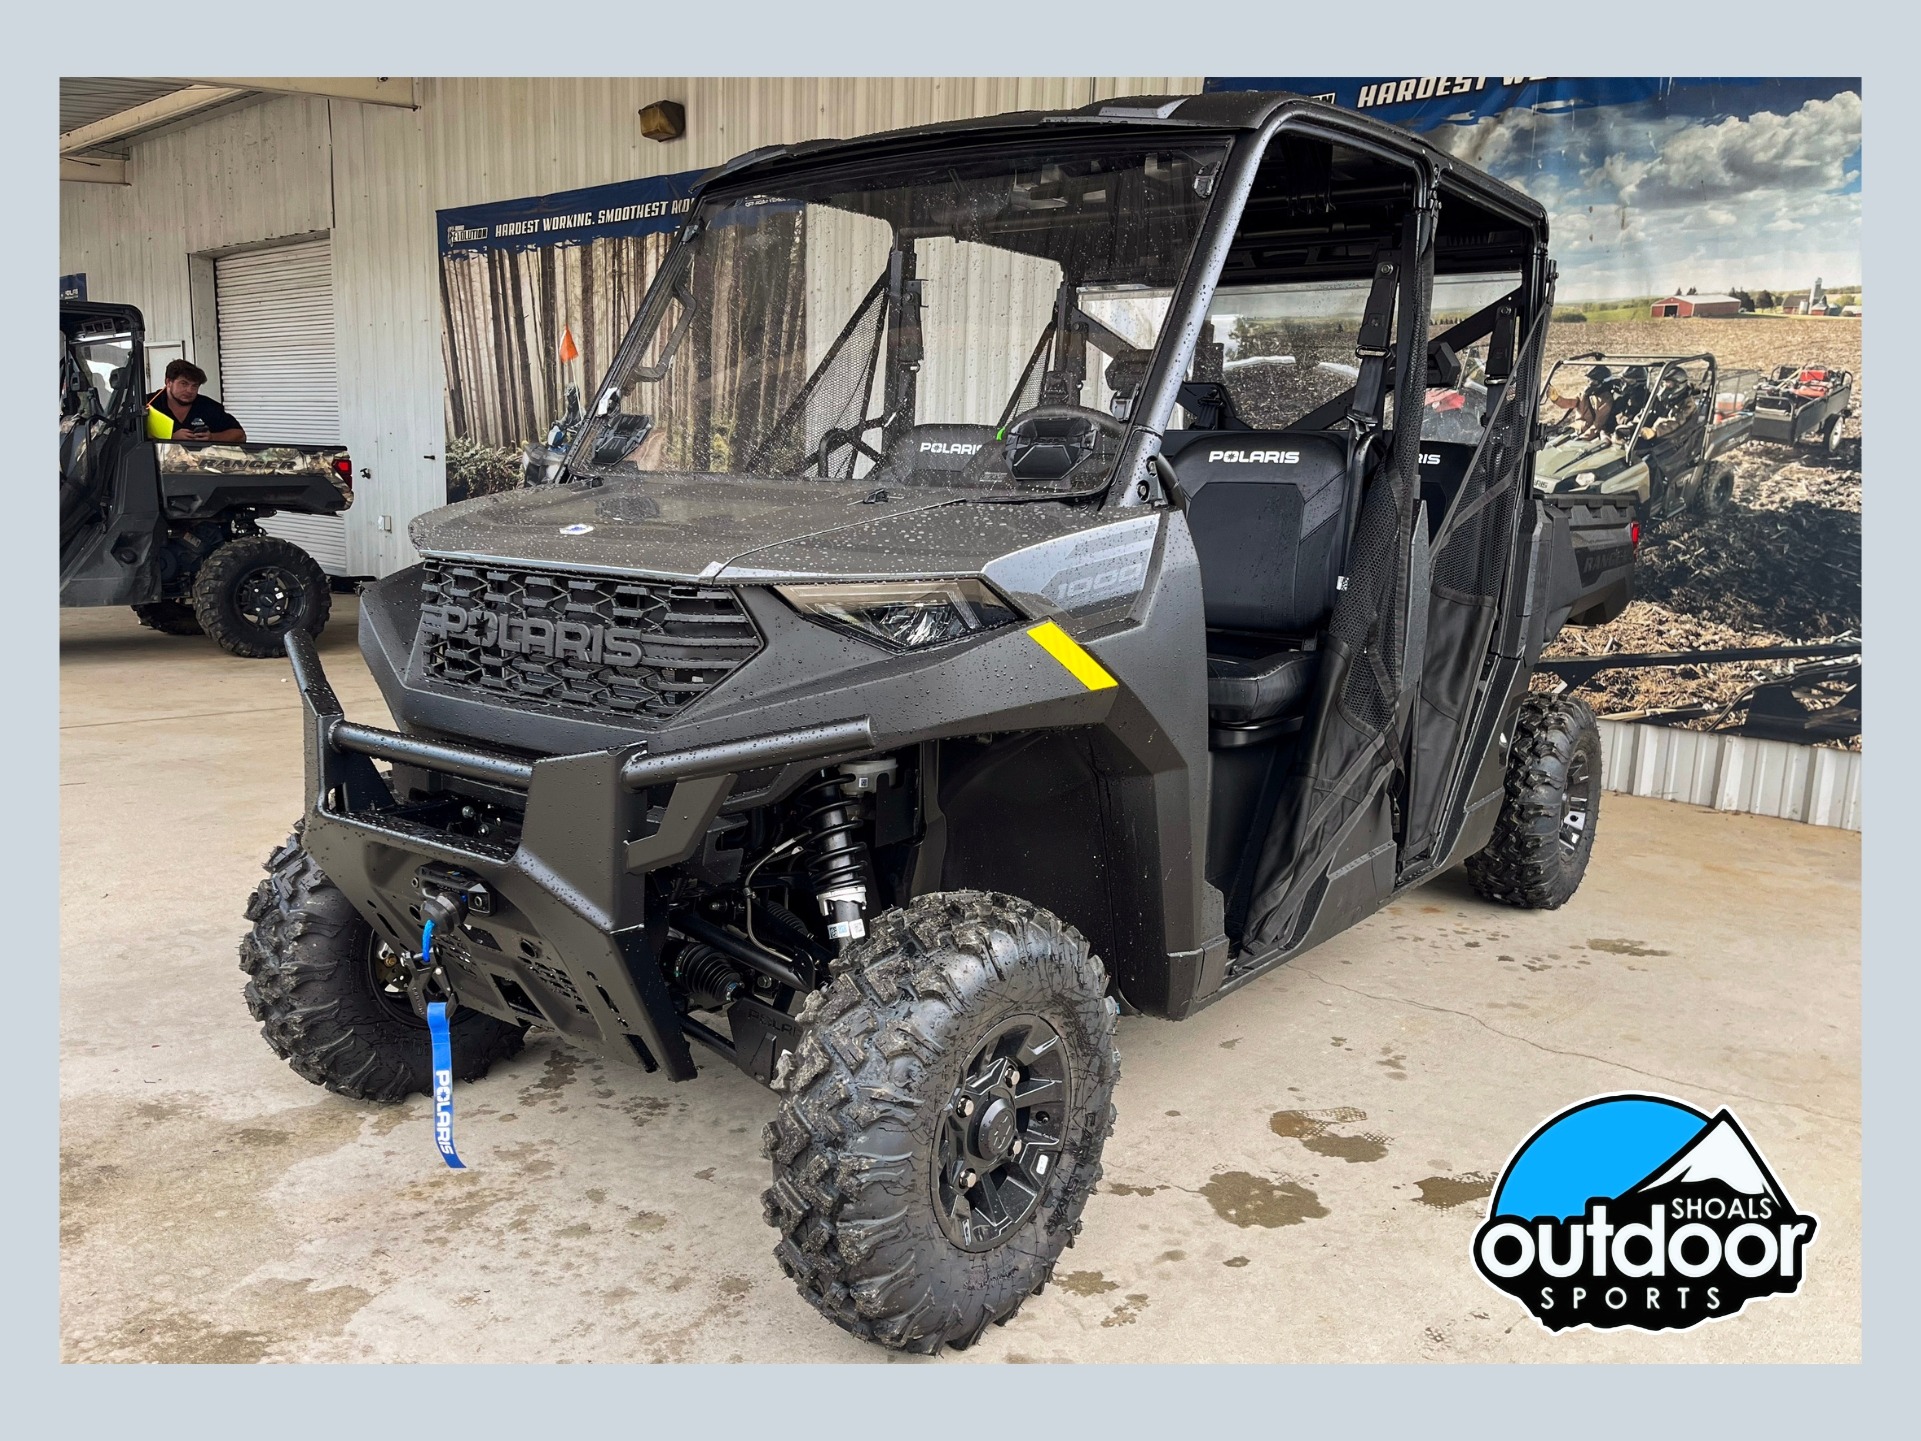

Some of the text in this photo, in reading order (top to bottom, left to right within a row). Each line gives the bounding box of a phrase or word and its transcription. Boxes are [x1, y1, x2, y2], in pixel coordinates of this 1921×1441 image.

[495, 198, 695, 237] HARDEST WORKING. SMOOTHEST RID
[199, 459, 297, 471] RANGER
[1208, 451, 1300, 464] POLARIS
[1056, 562, 1143, 600] 1000
[440, 604, 643, 667] POLARIS
[436, 1070, 454, 1155] POLARIS
